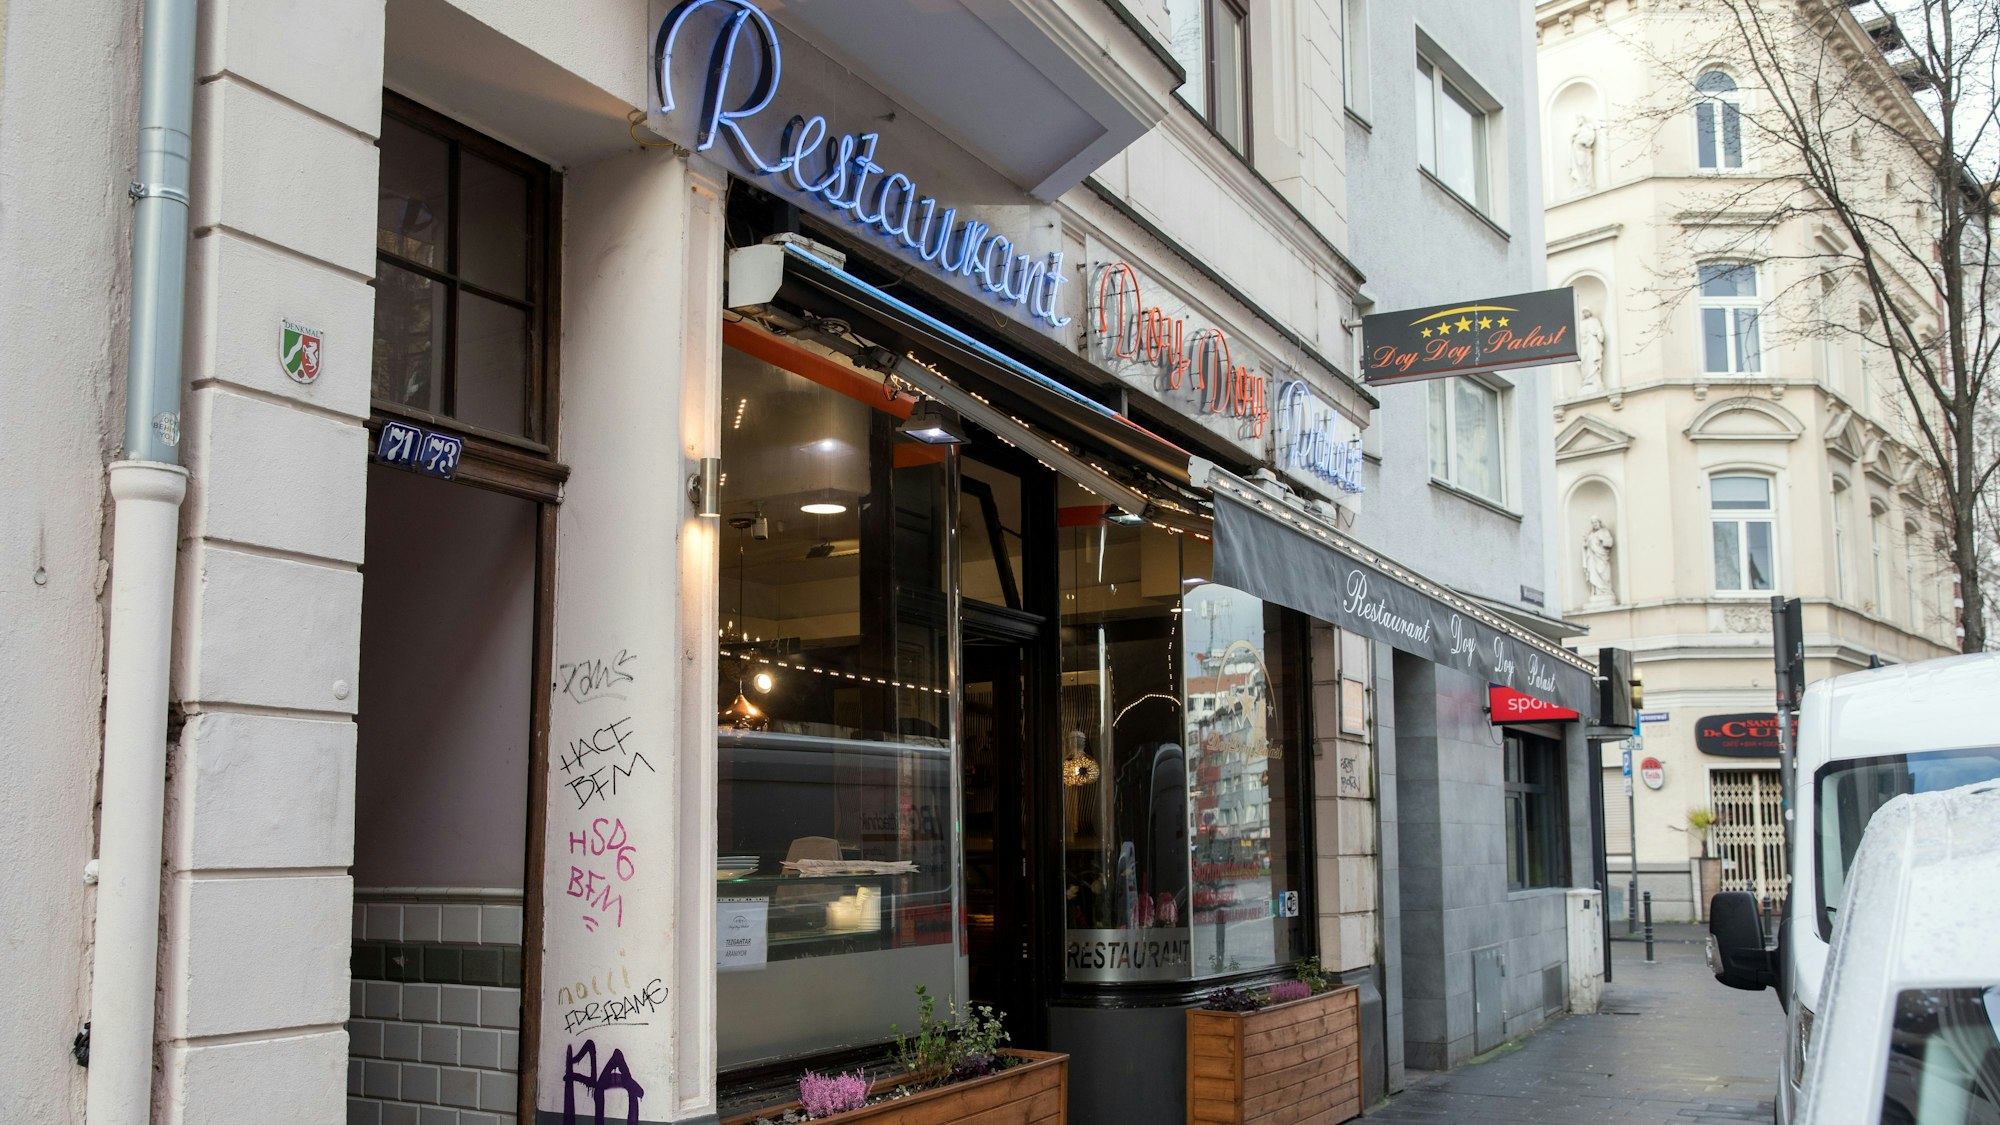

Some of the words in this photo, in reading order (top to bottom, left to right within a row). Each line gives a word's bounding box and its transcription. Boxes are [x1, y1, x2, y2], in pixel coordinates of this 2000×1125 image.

[655, 0, 1071, 328] Restaurant
[285, 320, 321, 338] DENKMAL
[1370, 345, 1418, 372] Doy
[1422, 338, 1471, 366] Doy
[1483, 325, 1567, 354] Palast
[1100, 261, 1190, 391] Doy
[1198, 328, 1270, 440] Doy
[387, 426, 414, 461] 71
[427, 437, 457, 479] 73
[1343, 569, 1431, 644] Restaurant
[1450, 614, 1476, 667] Doy
[1494, 636, 1515, 686] Doy
[1527, 653, 1556, 693] Palast
[1508, 697, 1560, 713] spor
[1067, 937, 1190, 970] RESTAURANT
